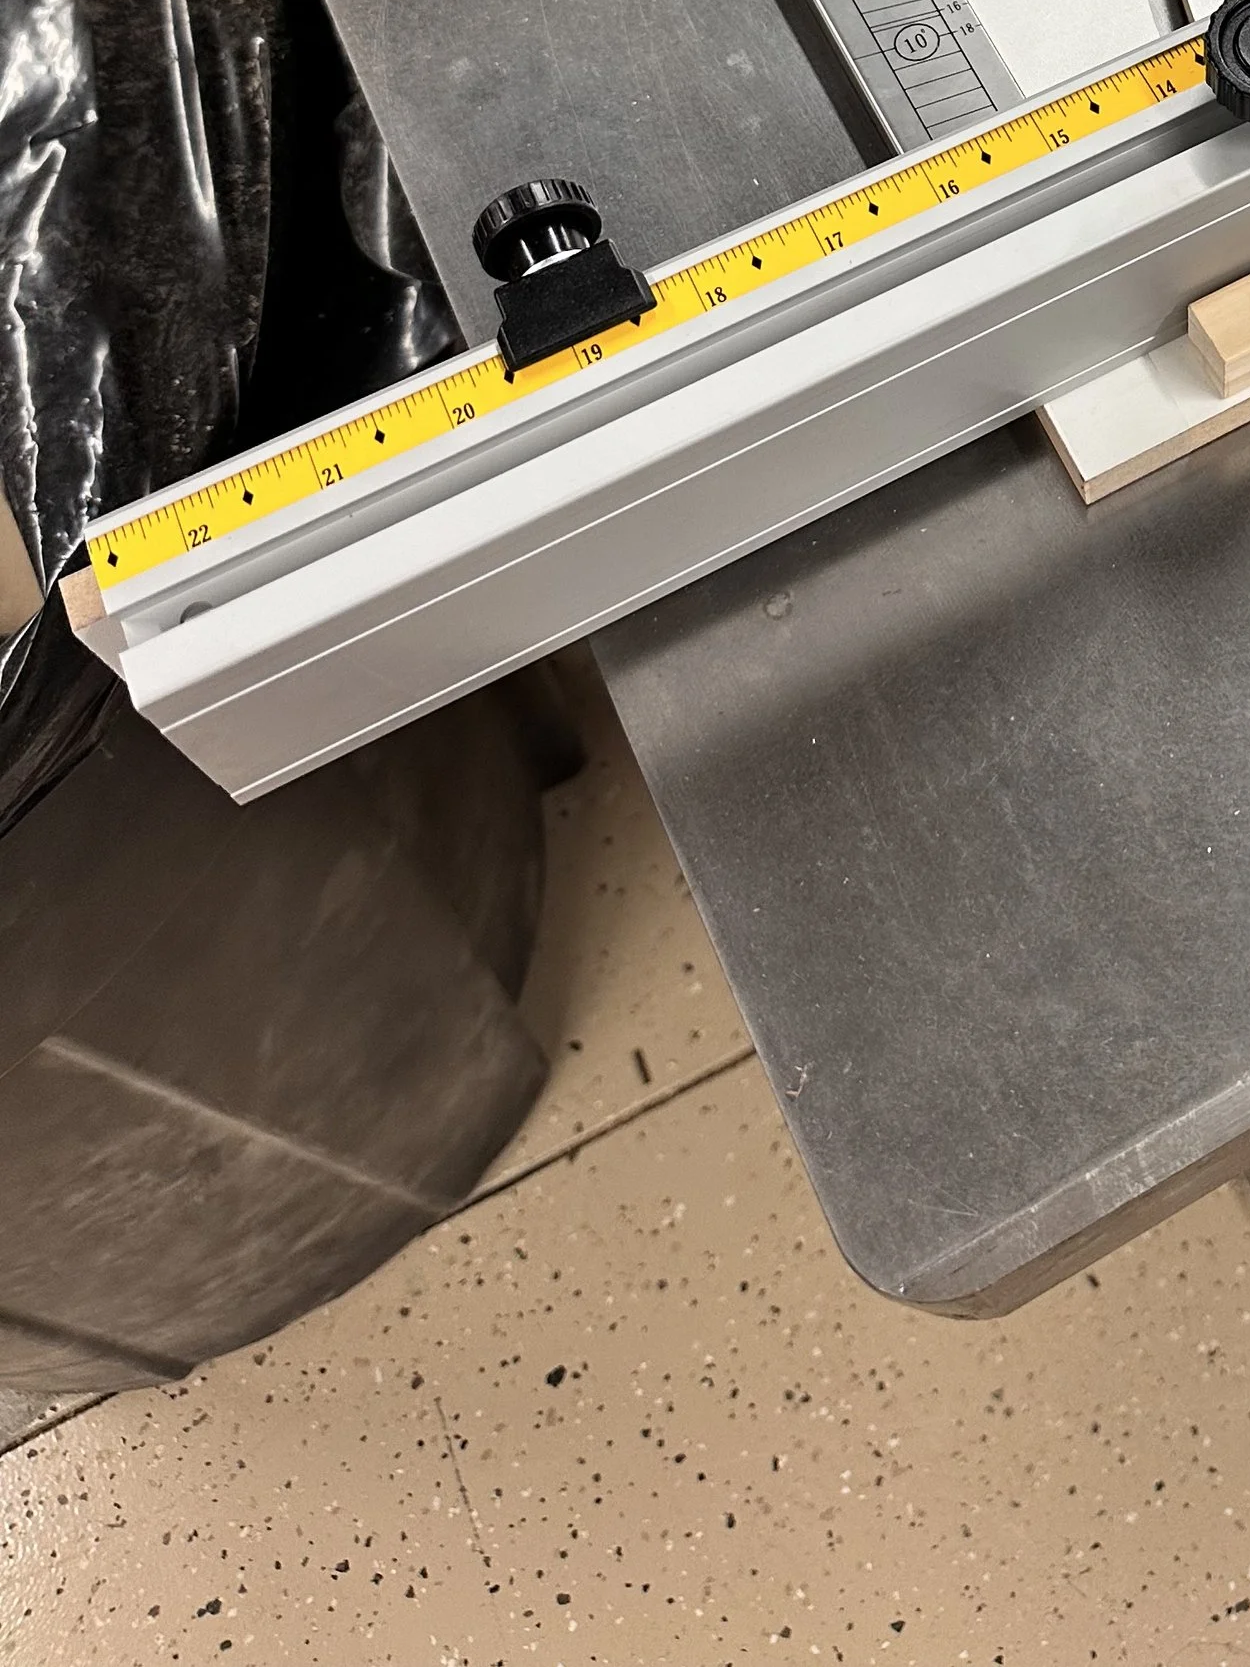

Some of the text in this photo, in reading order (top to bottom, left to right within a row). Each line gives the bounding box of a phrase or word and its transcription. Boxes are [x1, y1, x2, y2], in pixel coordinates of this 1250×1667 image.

[947, 0, 962, 14] 16
[959, 22, 975, 36] 18
[187, 524, 212, 548] 22
[321, 463, 344, 486] 21
[452, 402, 476, 426] 20
[581, 343, 603, 365] 19
[705, 286, 728, 308] 18
[825, 231, 845, 252] 17
[939, 179, 960, 200] 16
[1049, 129, 1071, 149] 15
[1157, 79, 1178, 99] 14
